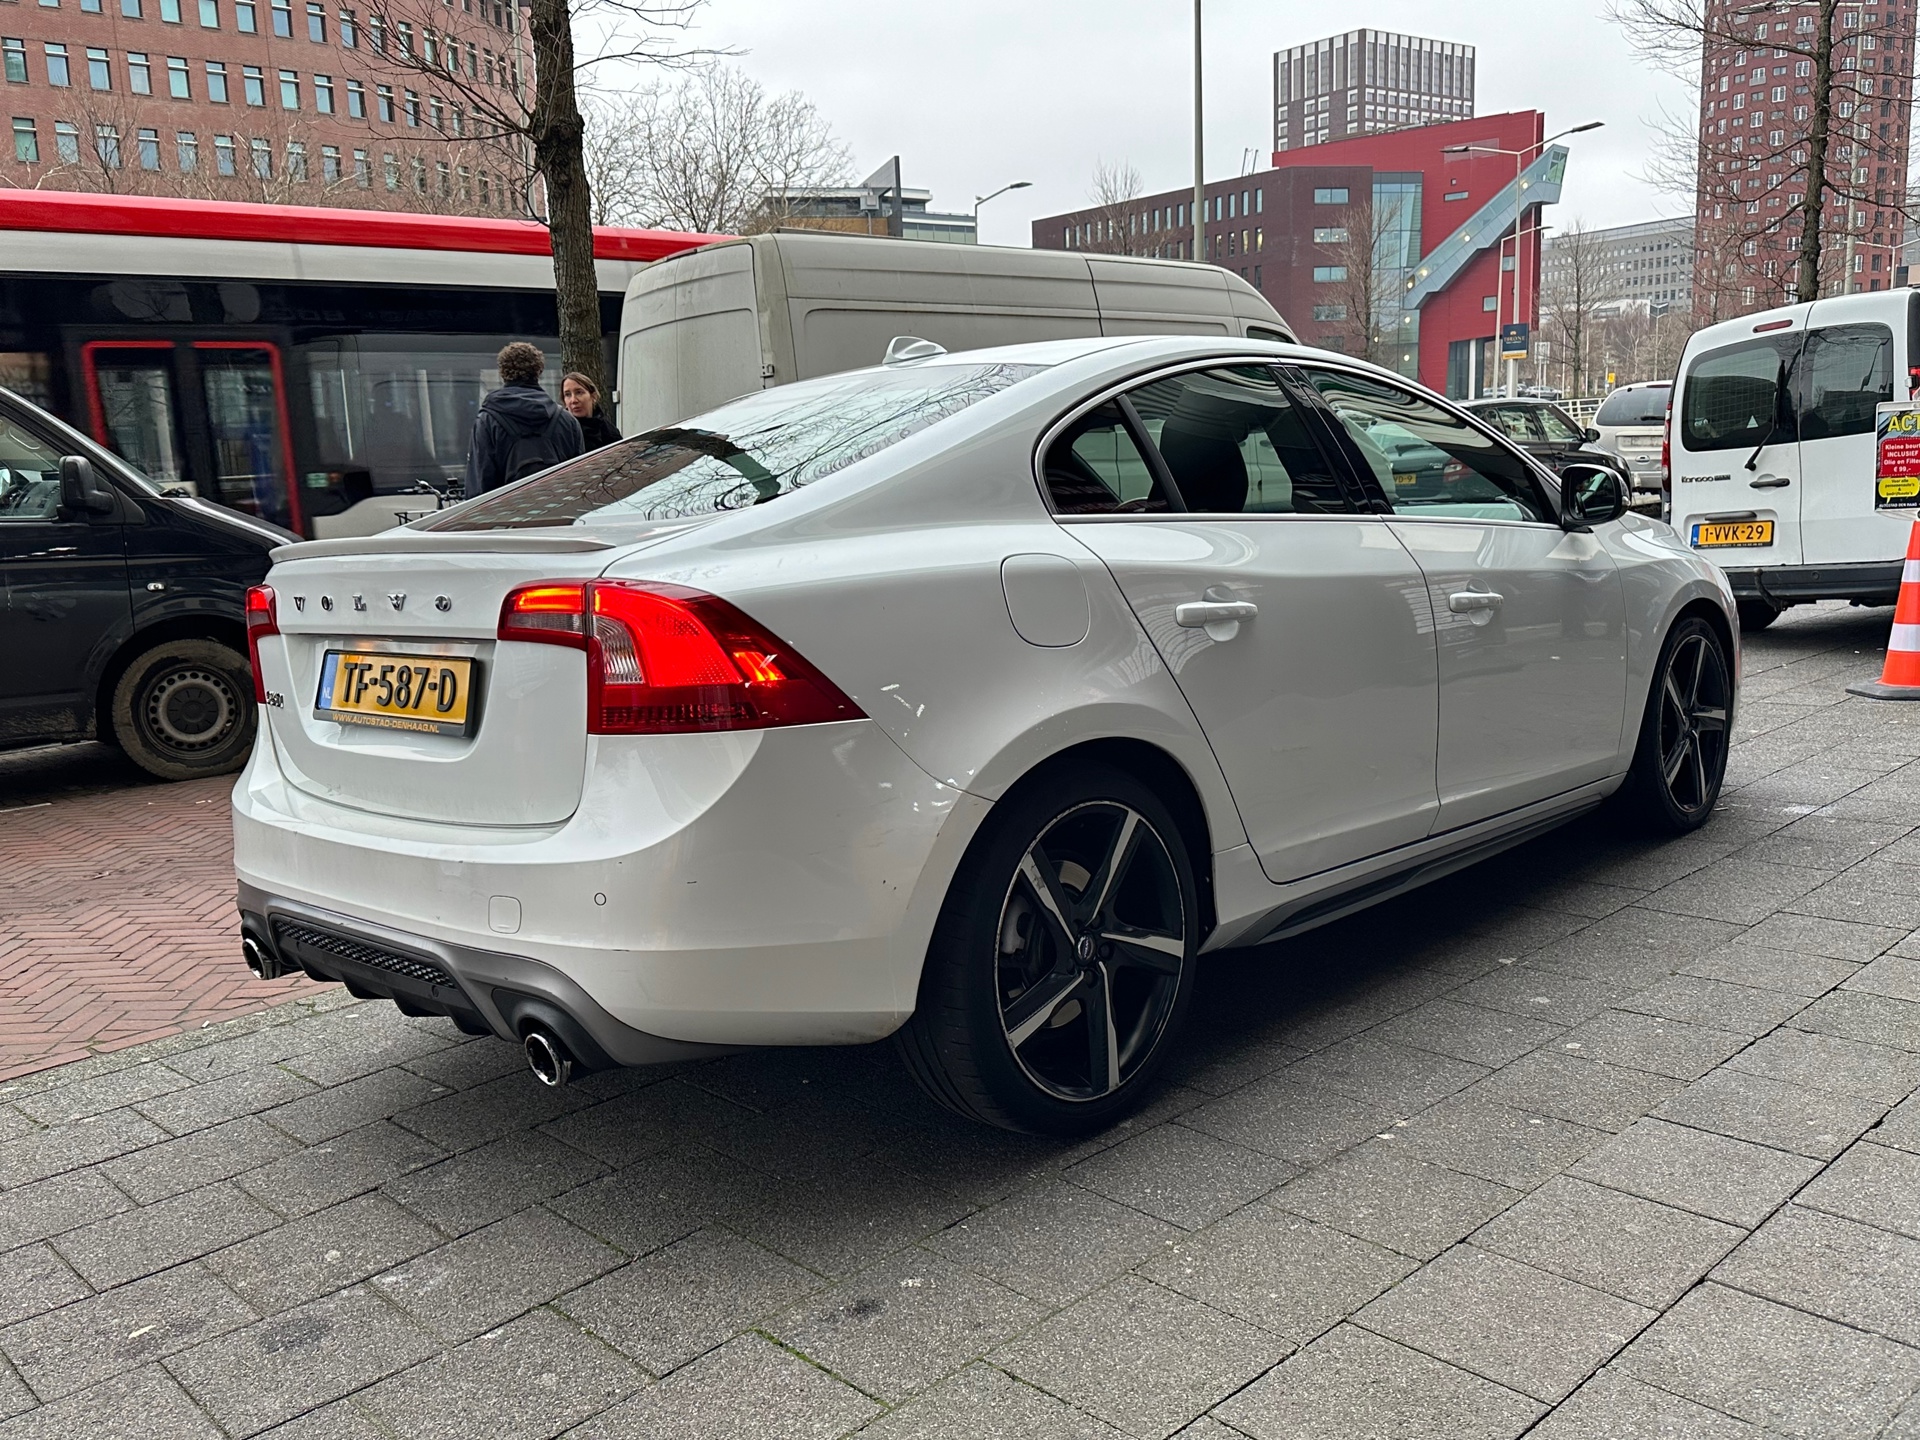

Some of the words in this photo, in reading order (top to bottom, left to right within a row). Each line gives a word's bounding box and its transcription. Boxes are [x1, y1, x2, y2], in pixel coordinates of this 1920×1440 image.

[1887, 450, 1919, 458] INCLUSIEF
[1704, 525, 1764, 542] 1-VVK-29
[293, 592, 452, 612] VOLVO
[322, 687, 332, 699] NL
[343, 662, 457, 712] TF-587-D
[332, 713, 440, 733] WWW.AUTOSTAD-DENHAAG.NL
